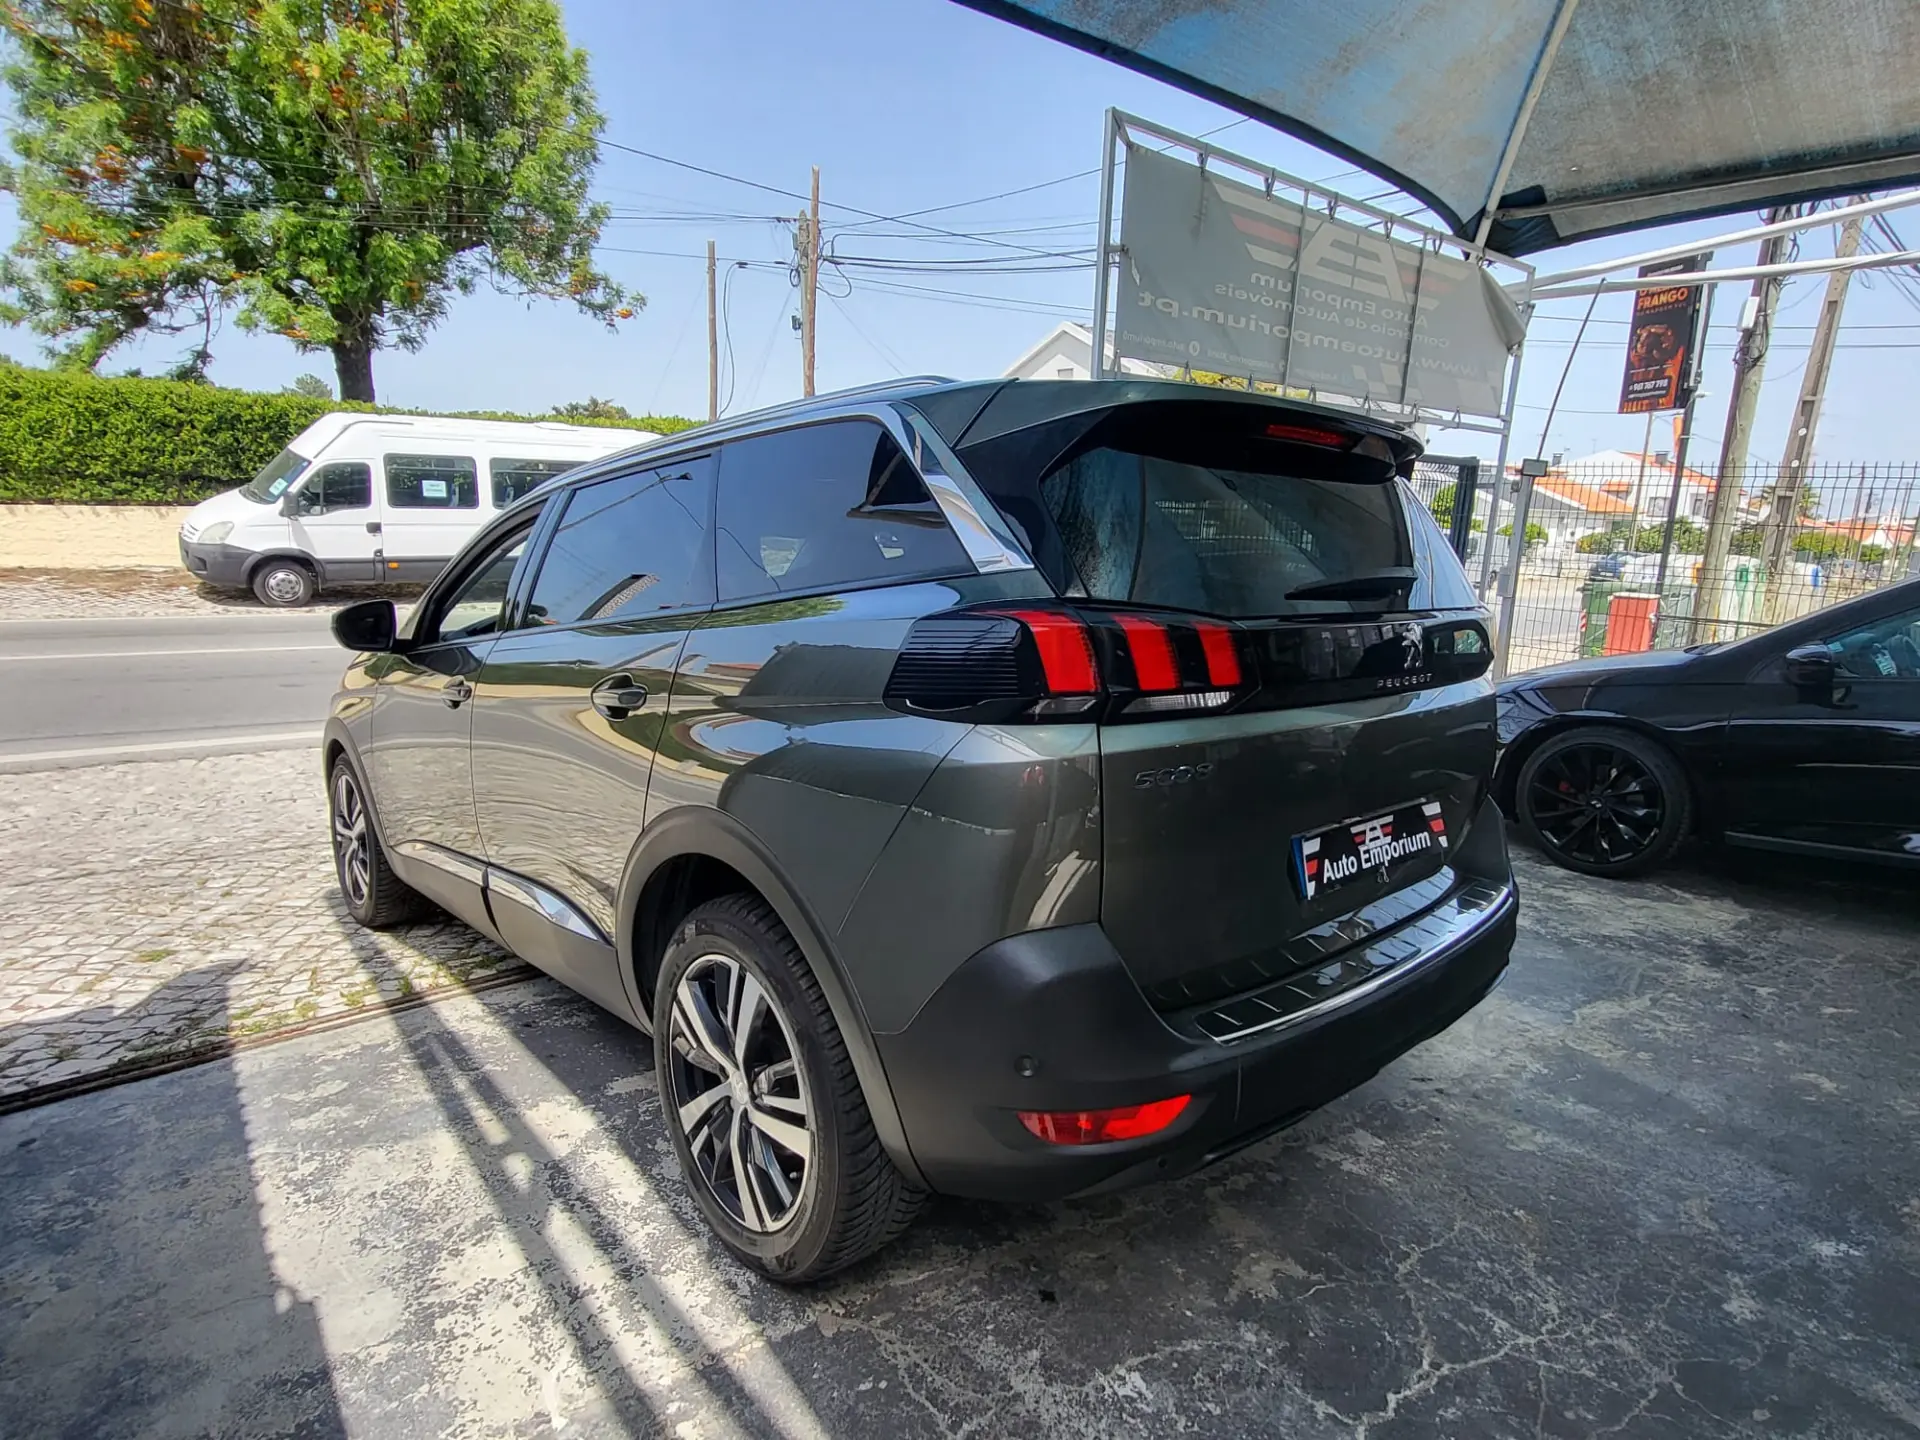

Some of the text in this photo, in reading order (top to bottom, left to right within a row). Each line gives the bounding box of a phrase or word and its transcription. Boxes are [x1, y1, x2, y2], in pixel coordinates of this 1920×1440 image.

[1637, 288, 1689, 311] FRANGO
[1377, 673, 1432, 688] PEUGEOT
[1323, 831, 1431, 884] Auto Emporium
